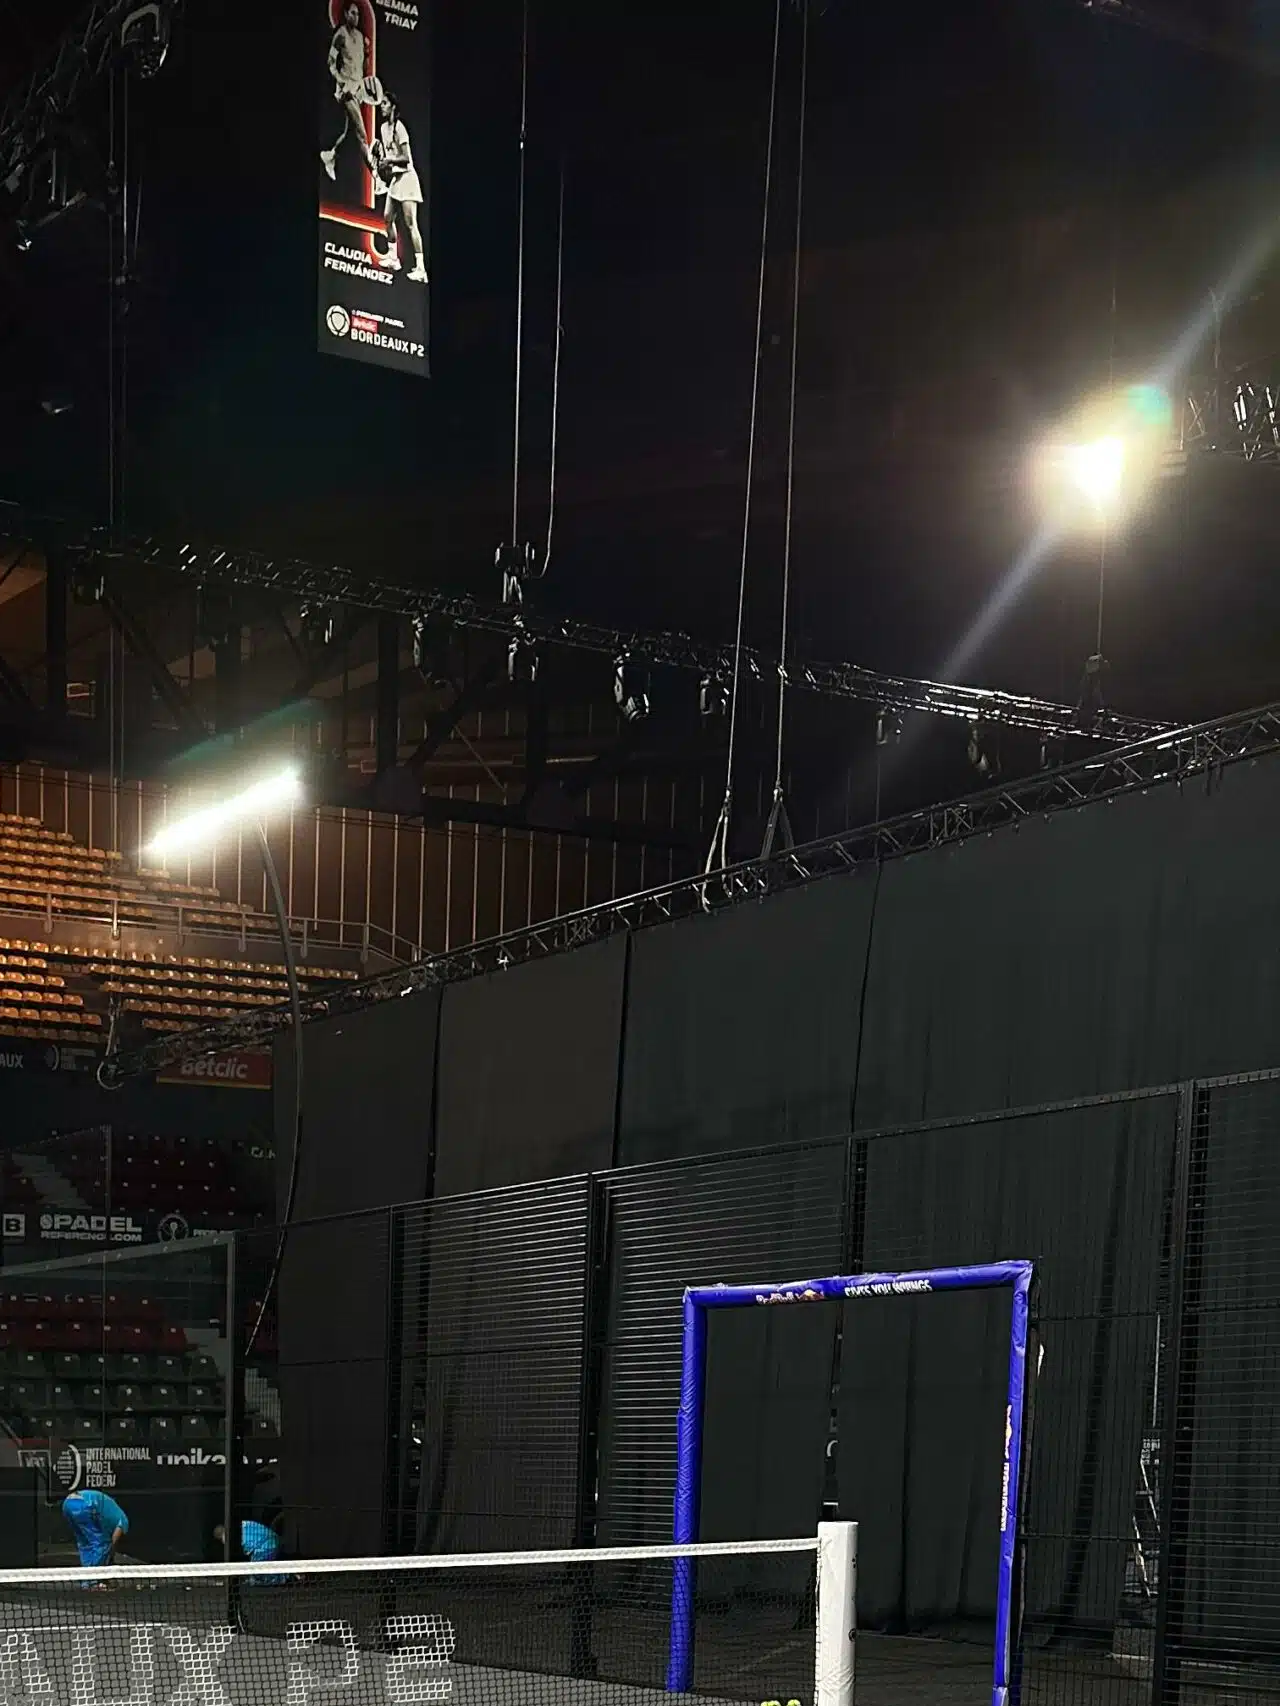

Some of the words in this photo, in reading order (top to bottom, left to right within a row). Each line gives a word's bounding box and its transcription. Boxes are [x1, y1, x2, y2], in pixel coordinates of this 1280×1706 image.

[384, 11, 418, 30] TRIAY
[324, 242, 373, 265] CLAUDIA
[324, 257, 394, 285] FERNÁNDEZ
[350, 328, 409, 353] BORDEAUX
[410, 342, 425, 357] P2
[40, 1231, 143, 1243] REFERENC.COM
[85, 1446, 152, 1461] INTERNATIONAL
[85, 1461, 114, 1474] PADEL
